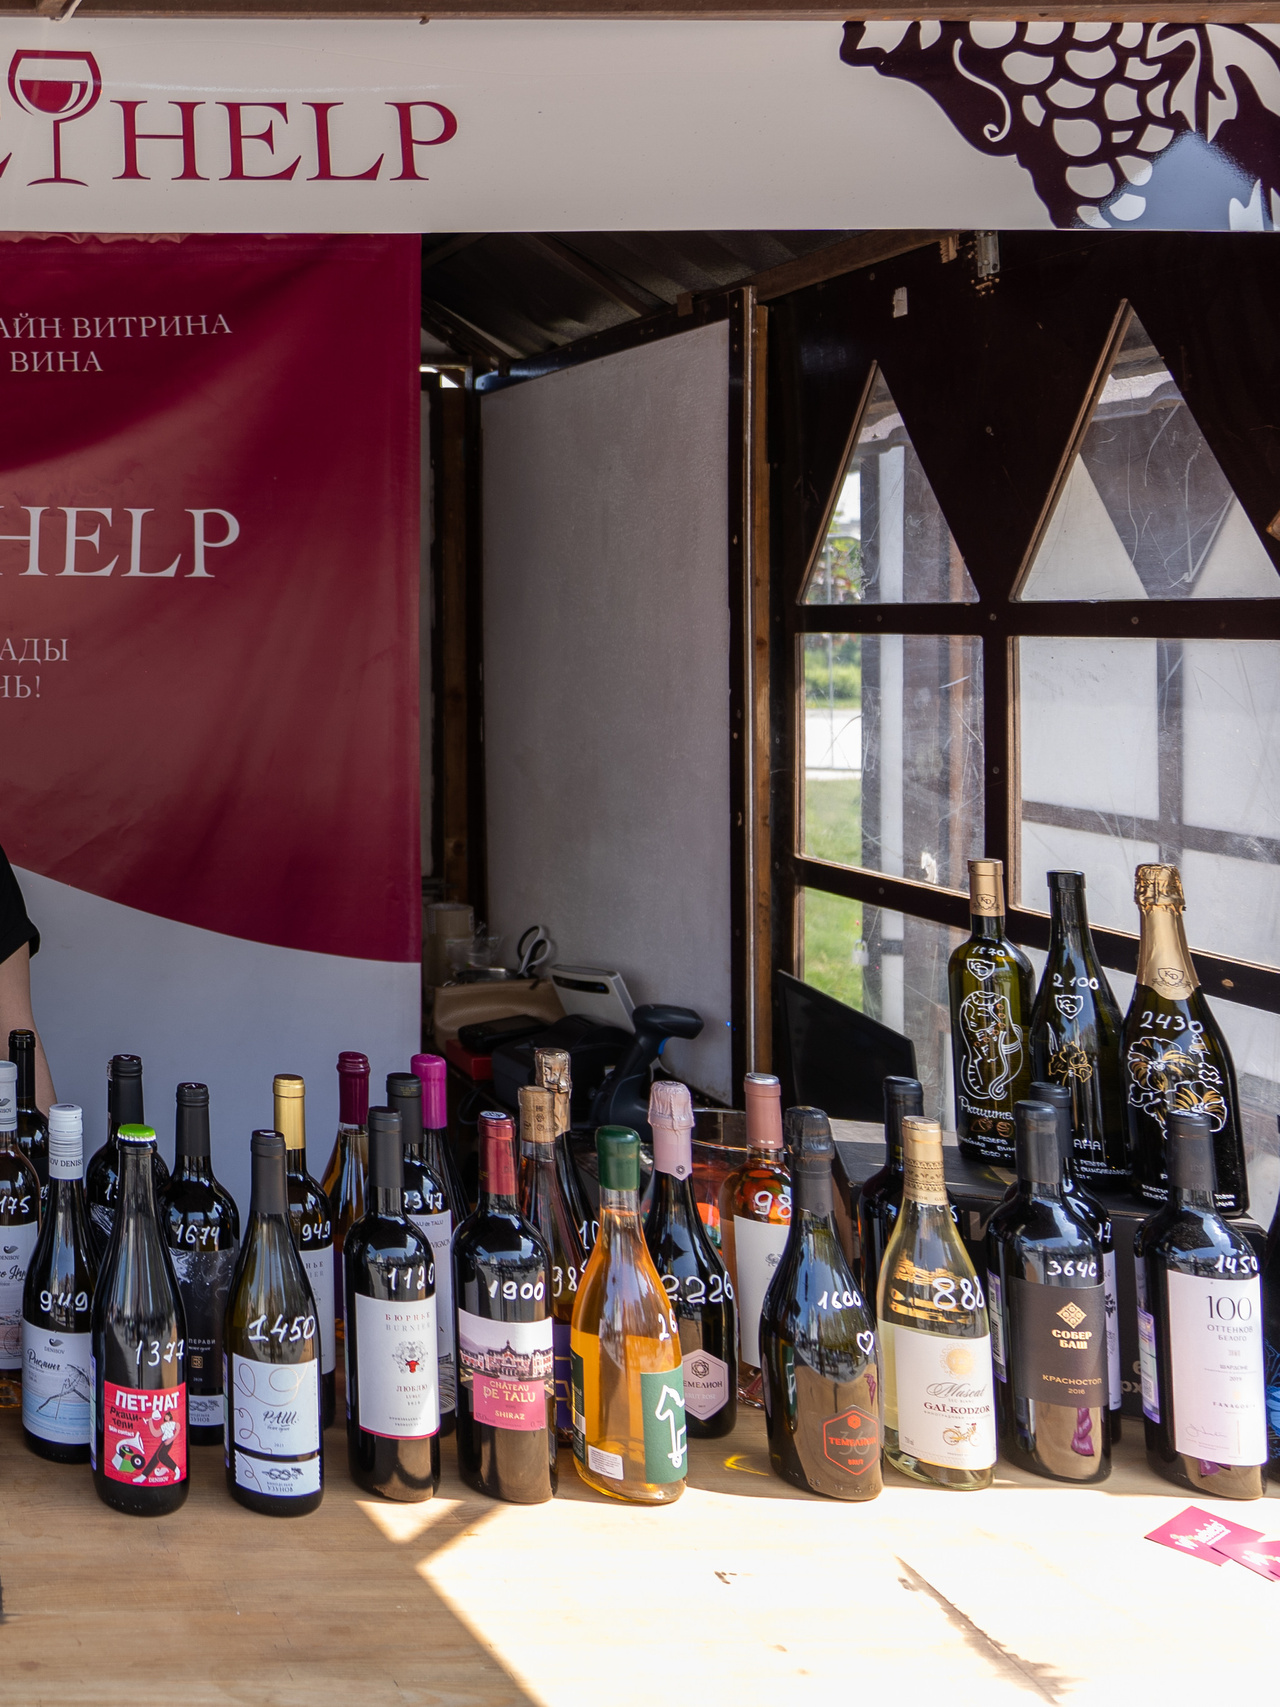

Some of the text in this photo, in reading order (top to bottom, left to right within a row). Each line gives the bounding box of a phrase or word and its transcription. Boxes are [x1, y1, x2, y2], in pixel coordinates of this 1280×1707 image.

[112, 100, 457, 182] HELP
[73, 312, 233, 339] ВИТРИНА
[9, 350, 105, 374] ВИНА
[1052, 973, 1100, 990] 2100
[1140, 1010, 1204, 1034] 2430
[388, 1262, 435, 1291] 1120
[487, 1279, 545, 1301] 1900
[817, 1290, 862, 1310] 1600
[1206, 1294, 1253, 1322] 100
[385, 1311, 431, 1322] БЮРНЬЕ
[248, 1313, 317, 1343] 1450
[1051, 1329, 1093, 1340] СОБЕР
[1206, 1324, 1254, 1334] ОТТЕНКОВ
[188, 1337, 216, 1345] ПЕРАВИ
[1059, 1338, 1088, 1350] БАШ
[1218, 1334, 1248, 1342] БЕЛОГО
[489, 1380, 530, 1392] CHÂTEAU
[683, 1380, 723, 1389] ЕМЕЛИОН
[1042, 1374, 1103, 1385] КРАСНОСТОП
[115, 1390, 181, 1412] ПЕТ-НАТ
[502, 1389, 537, 1403] TALU
[190, 1413, 210, 1423] ЗУНОВ
[494, 1410, 526, 1421] SHIRAZ
[111, 1417, 134, 1430] тели
